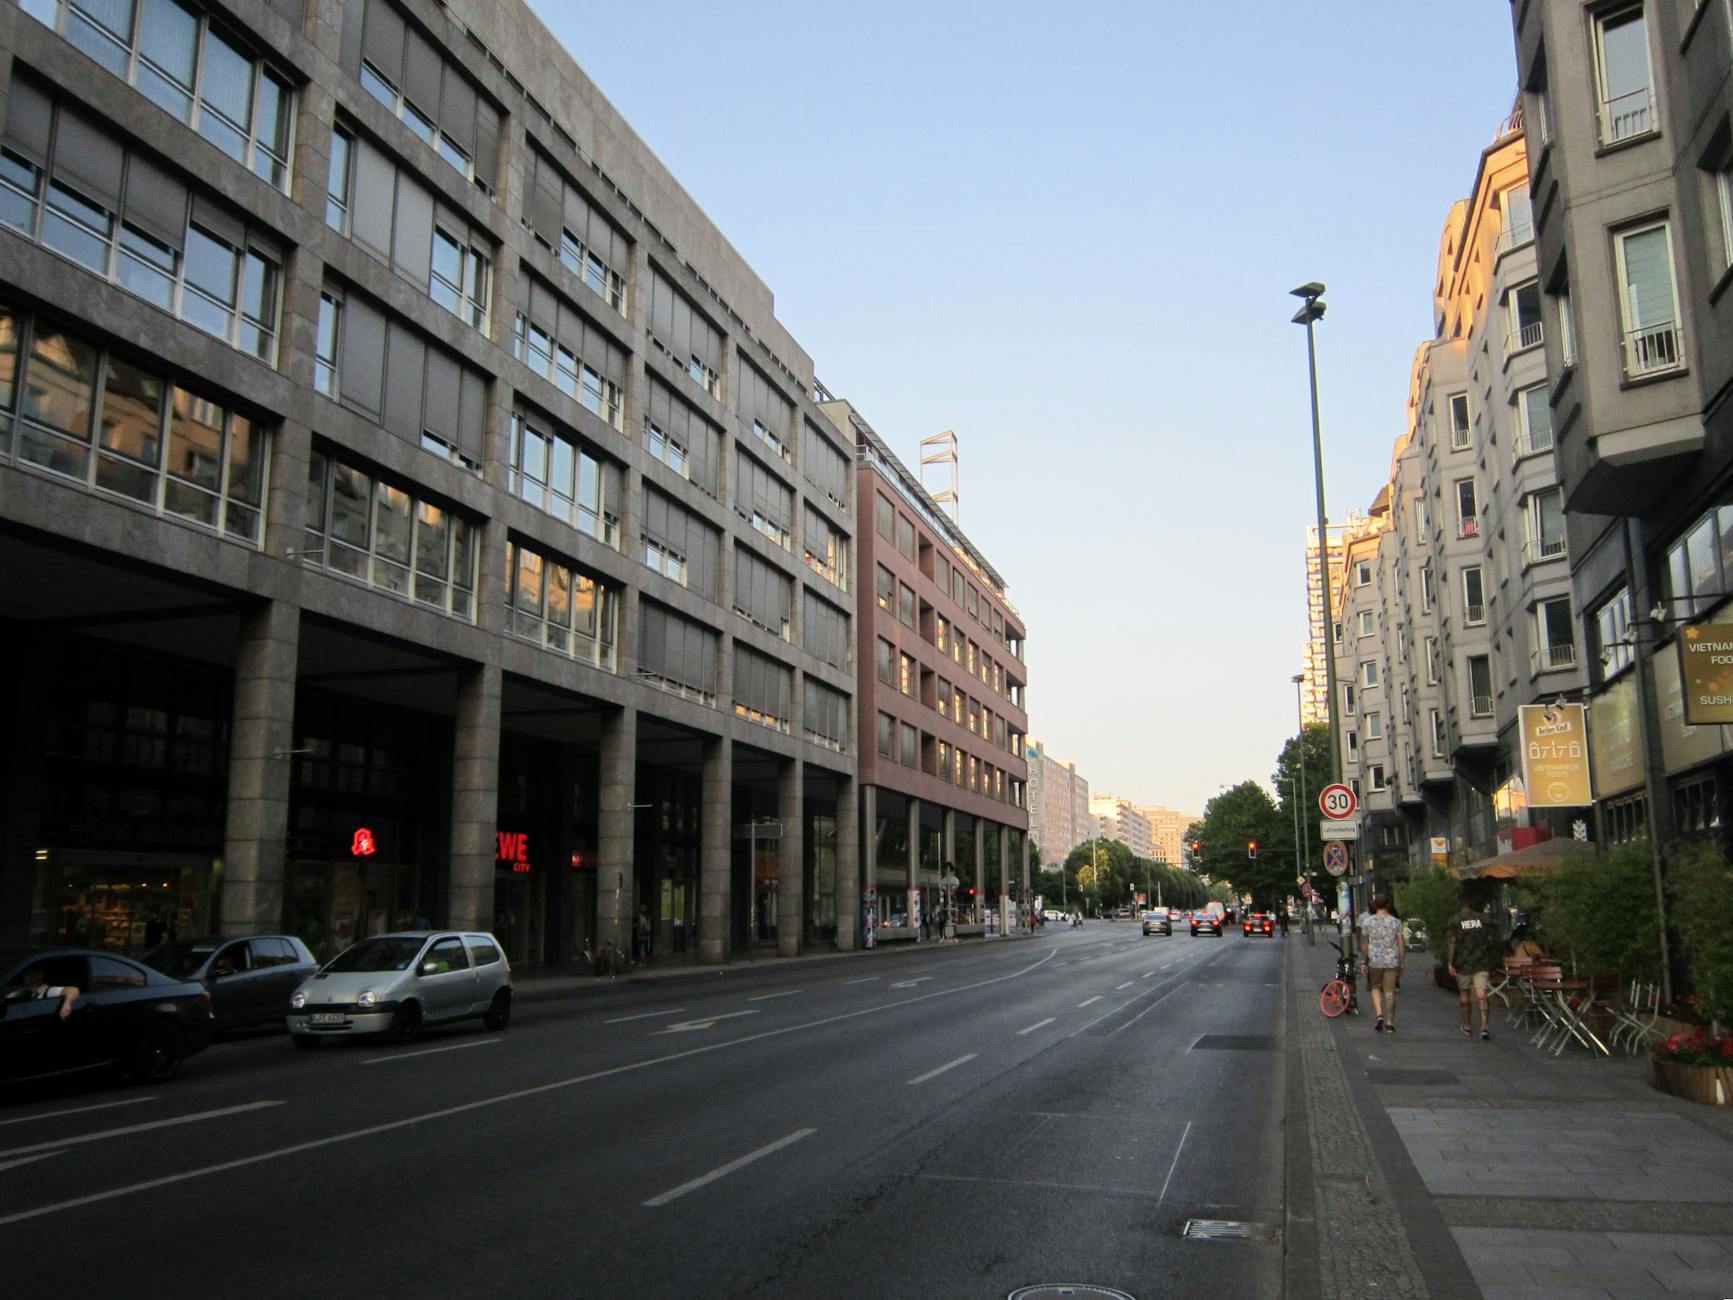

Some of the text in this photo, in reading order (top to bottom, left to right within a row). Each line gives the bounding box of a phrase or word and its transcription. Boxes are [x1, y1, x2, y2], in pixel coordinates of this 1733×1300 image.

[1028, 766, 1039, 828] HOTEL
[1327, 793, 1348, 810] 30
[496, 832, 528, 861] WE
[512, 863, 531, 873] CITY
